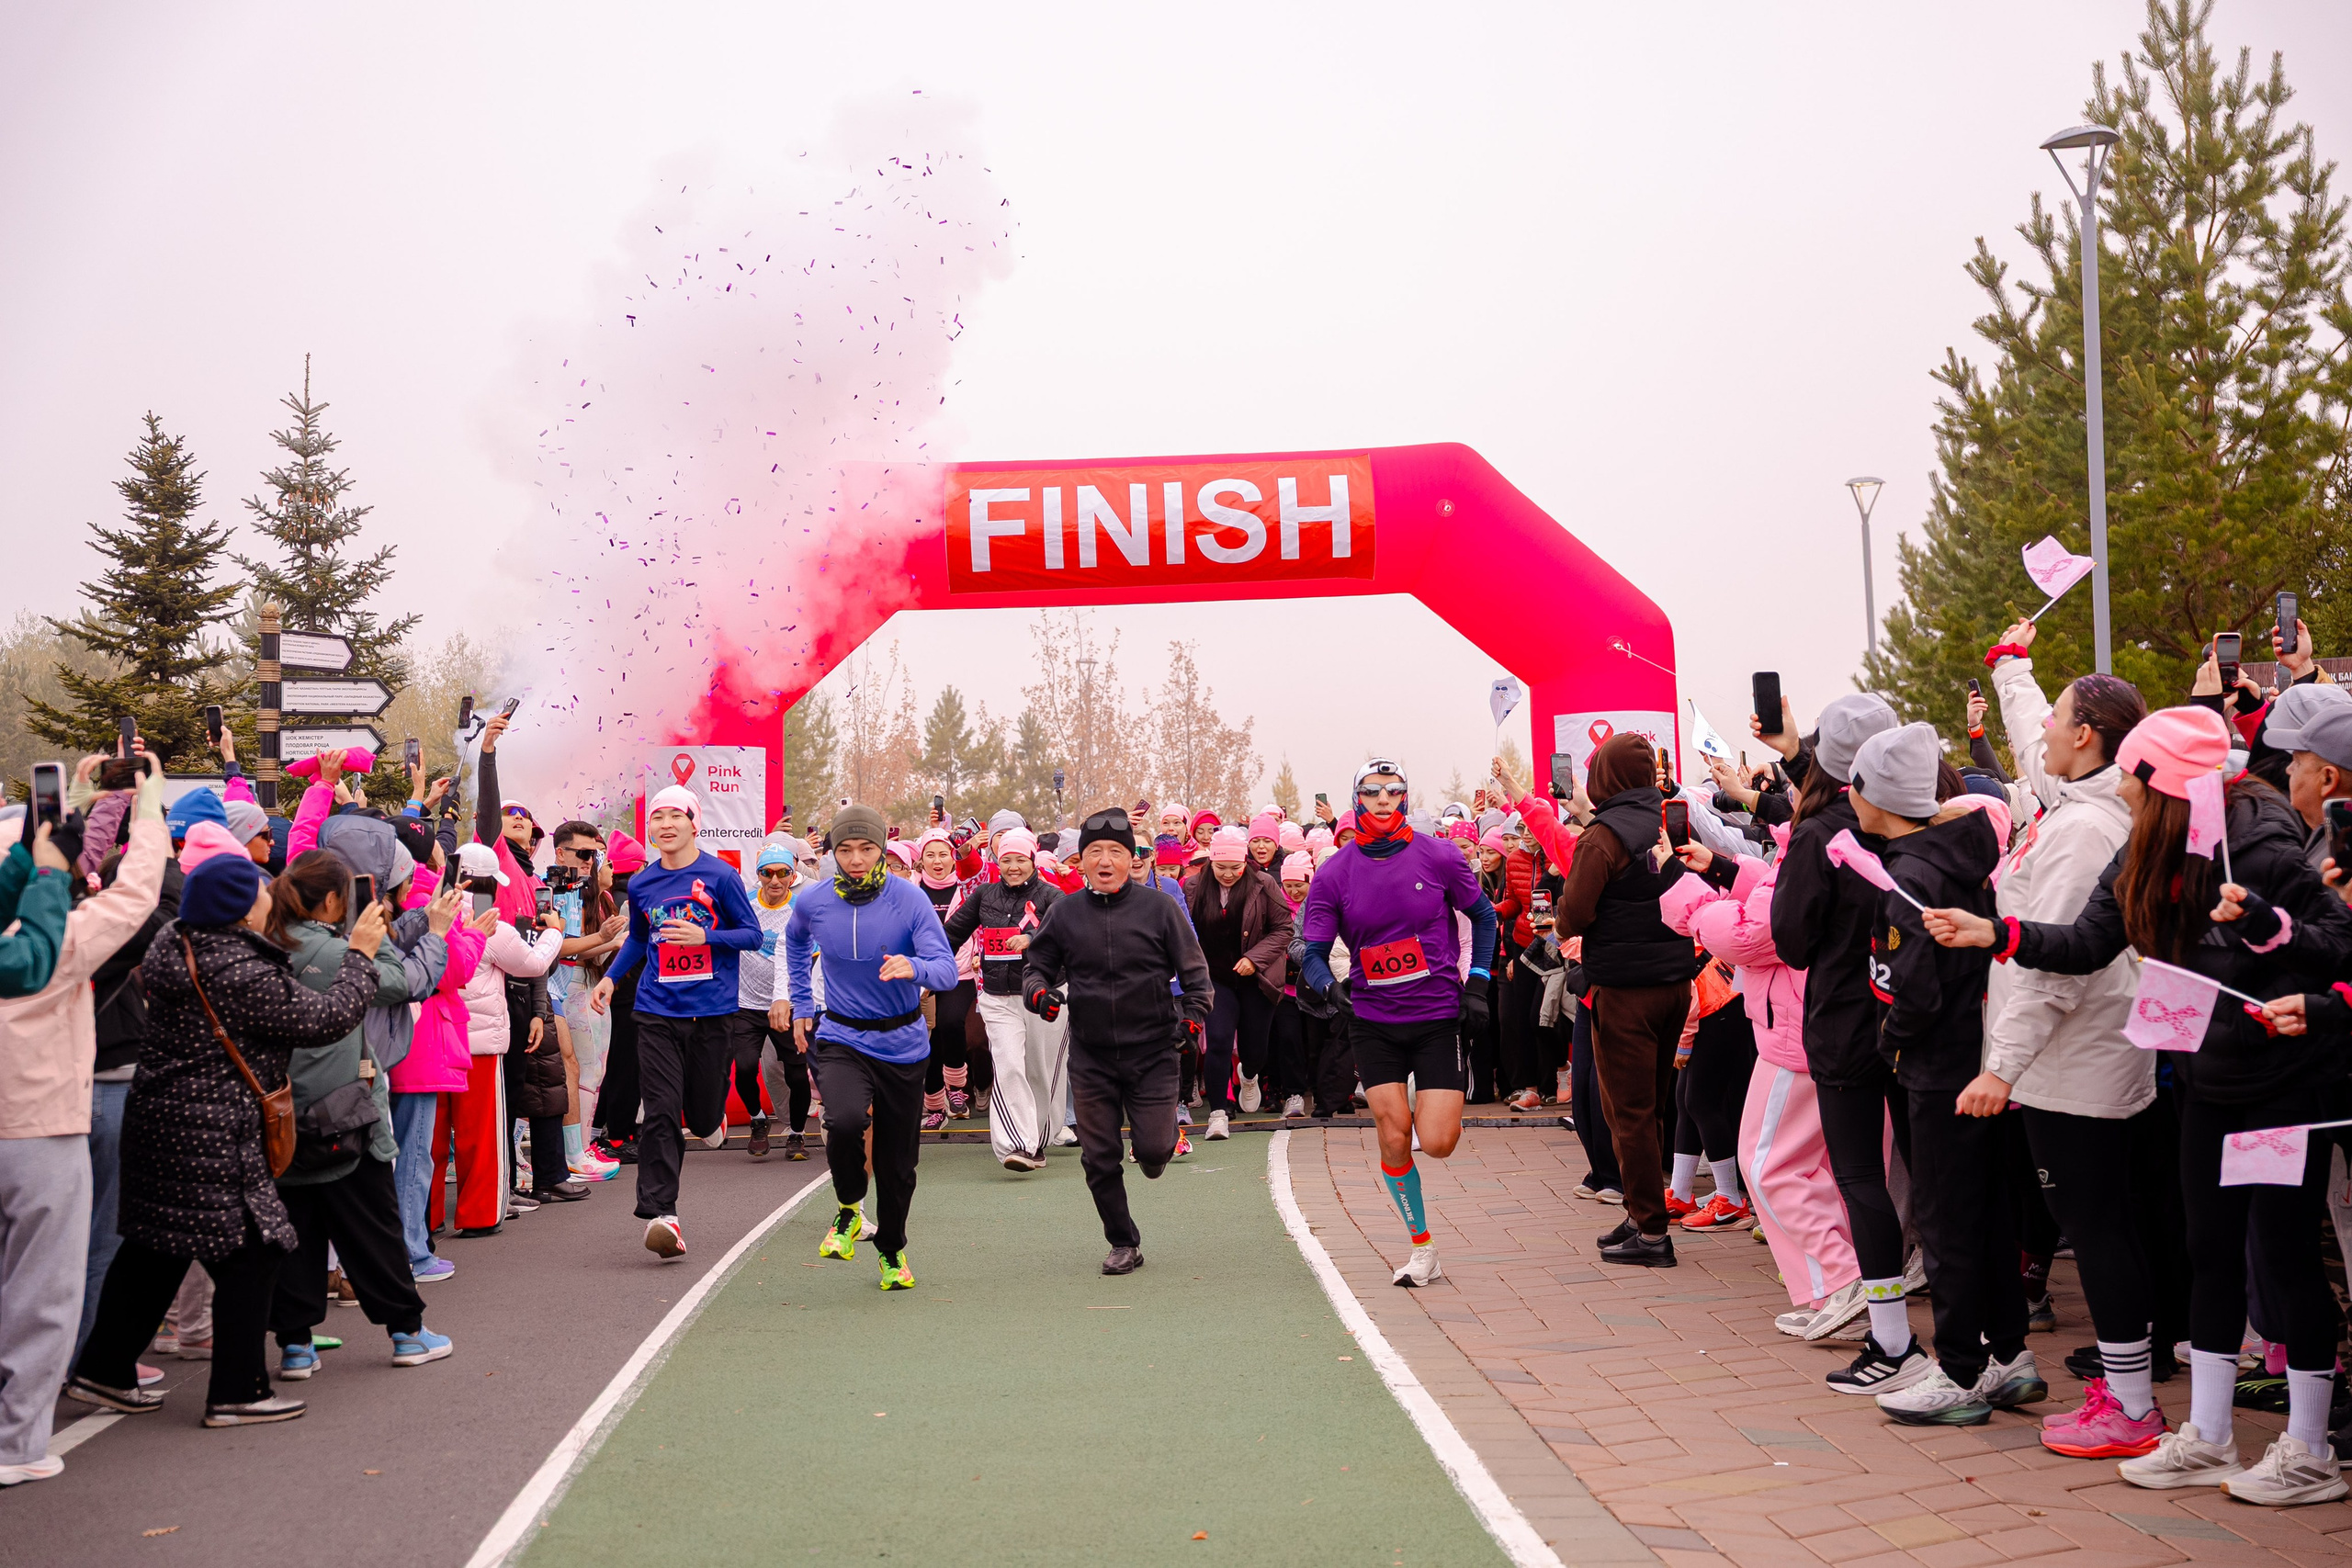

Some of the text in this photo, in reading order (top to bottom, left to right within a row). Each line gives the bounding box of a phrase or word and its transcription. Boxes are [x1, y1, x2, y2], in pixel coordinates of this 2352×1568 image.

[969, 474, 1351, 572] FINISH
[707, 764, 741, 777] Pink
[710, 781, 740, 793] Run
[695, 827, 763, 838] entercredit
[666, 953, 705, 972] 403
[1371, 953, 1418, 975] 409
[1399, 1193, 1415, 1222] AONIJIE
